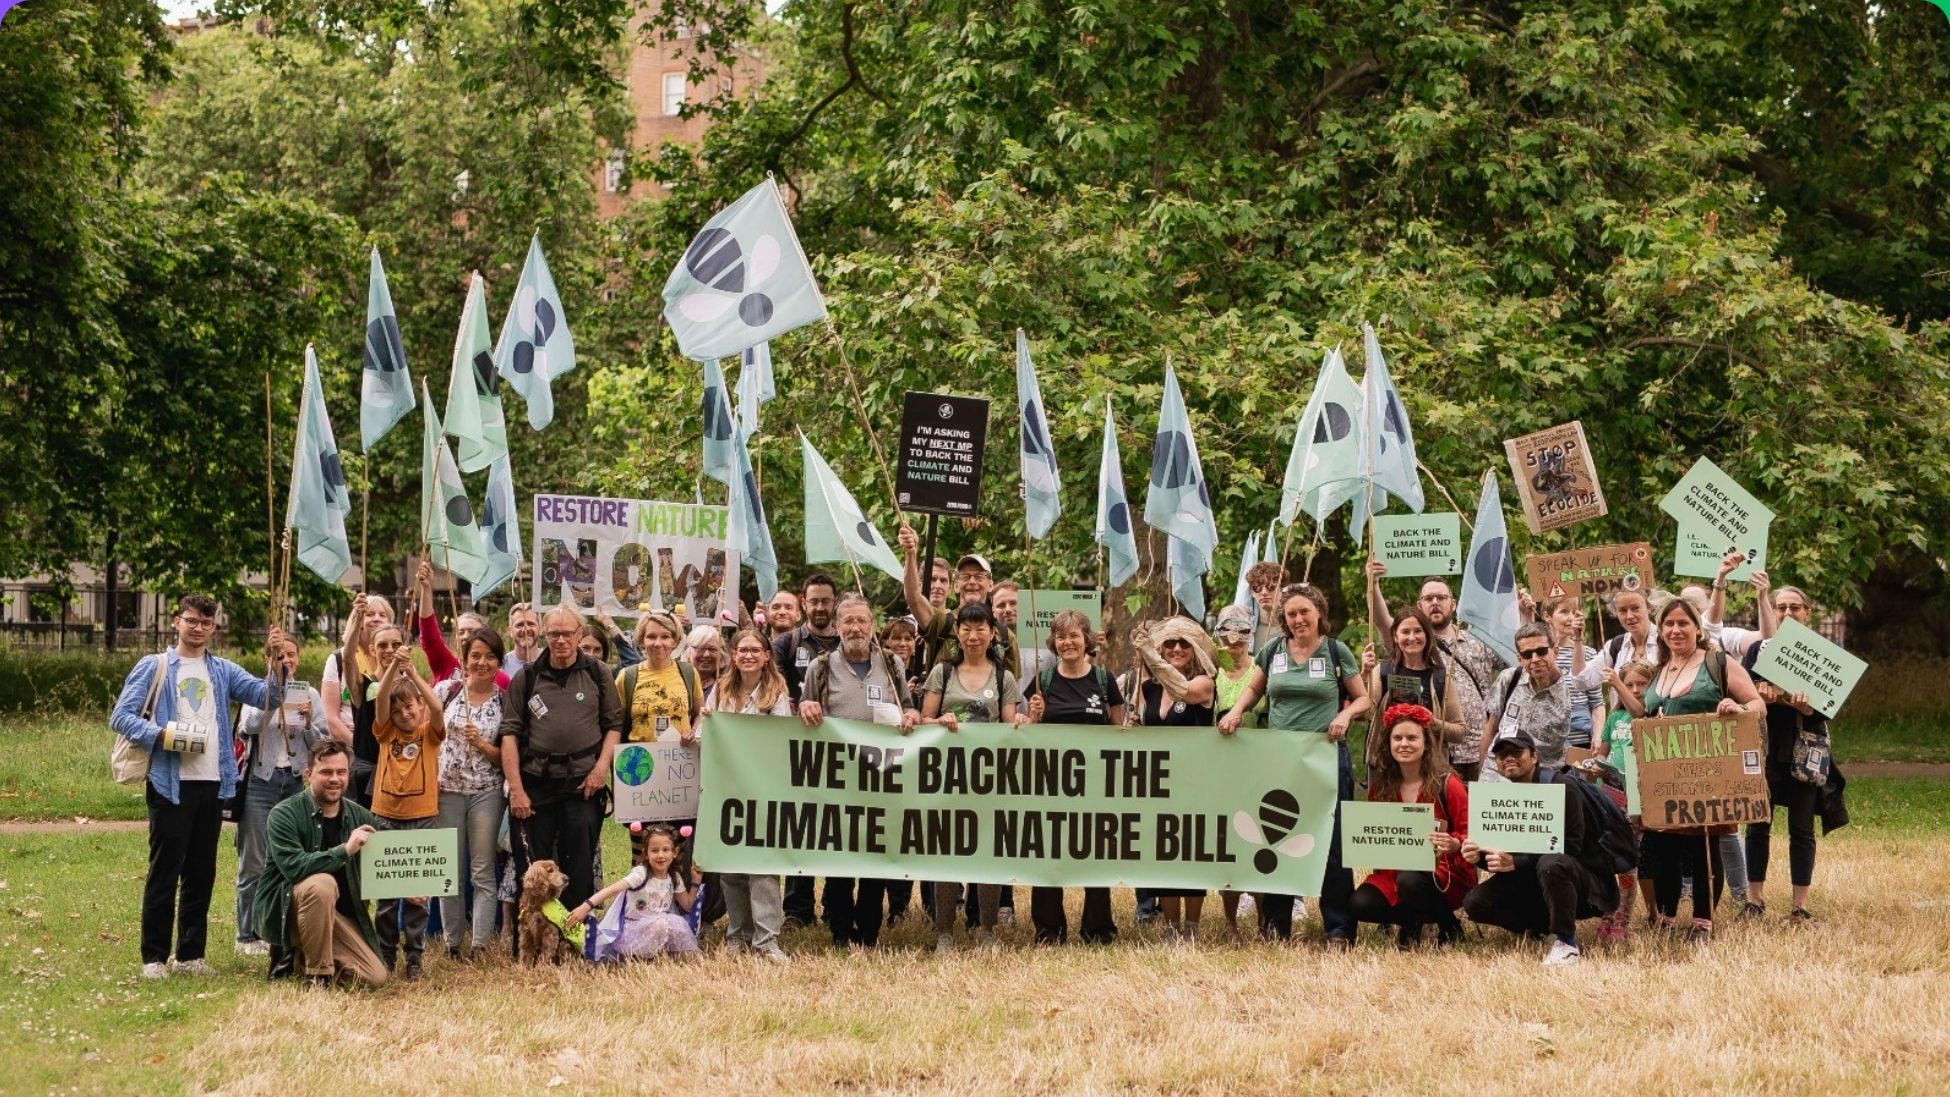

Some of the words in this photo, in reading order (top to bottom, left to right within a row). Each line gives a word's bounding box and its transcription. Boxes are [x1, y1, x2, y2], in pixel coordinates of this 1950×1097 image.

[917, 426, 932, 435] I'M
[934, 428, 970, 439] ASKING
[912, 437, 927, 446] MY
[929, 439, 956, 450] NEXT
[957, 442, 973, 451] MP
[909, 448, 923, 457] TO
[925, 450, 951, 460] BACK
[954, 453, 973, 462] THE
[1526, 440, 1577, 467] STOP
[907, 460, 950, 471] CLIMATE
[951, 464, 972, 473] AND
[907, 471, 947, 482] NATURE
[949, 476, 970, 485] BILL
[1537, 491, 1597, 517] ECOCIDE
[1705, 482, 1731, 505] BACK
[1730, 502, 1749, 521] THE
[1690, 485, 1729, 519] CLIMATE
[1728, 517, 1748, 535] AND
[537, 498, 628, 527] RESTORE
[638, 504, 728, 540] NATURE
[1684, 495, 1719, 527] NATURE
[1718, 524, 1738, 543] BILL
[1393, 529, 1419, 538] BACK
[1422, 528, 1442, 536] THE
[1385, 540, 1427, 549] CLIMATE
[1430, 539, 1451, 547] AND
[1387, 551, 1426, 560] NATURE
[1429, 550, 1450, 558] BILL
[1691, 550, 1722, 559] NATUR
[1538, 555, 1580, 573] SPEAK
[1587, 555, 1602, 568] UP
[1609, 553, 1637, 568] FOR
[541, 538, 725, 619] NOW
[1560, 566, 1639, 582] NATURE
[1580, 578, 1624, 594] NOW
[1794, 641, 1821, 661] BACK
[1822, 657, 1842, 673] THE
[1780, 646, 1822, 675] CLIMATE
[1821, 672, 1843, 687] AND
[1775, 656, 1814, 683] NATURE
[1814, 680, 1834, 697] BILL
[1641, 719, 1740, 764] NATURE
[657, 748, 693, 761] THERE
[668, 762, 696, 781] NO
[789, 739, 904, 794] WE'RE
[918, 746, 1086, 798] BACKING
[1101, 750, 1170, 799] THE
[632, 785, 693, 807] PLANET
[1491, 799, 1519, 808] BACK
[1523, 800, 1544, 809] THE
[1481, 811, 1528, 820] CLIMATE
[1531, 812, 1554, 821] AND
[719, 798, 886, 854] CLIMATE
[900, 808, 978, 857] AND
[994, 809, 1141, 861] NATURE
[1155, 813, 1237, 863] BILL
[1363, 826, 1413, 835] RESTORE
[1482, 823, 1525, 832] NATURE
[1529, 824, 1552, 834] BILL
[1352, 836, 1395, 846] NATURE
[1399, 838, 1425, 846] NOW
[384, 846, 413, 855] BACK
[416, 845, 438, 854] THE
[374, 858, 422, 868] CLIMATE
[424, 857, 447, 865] AND
[376, 870, 420, 879] NATURE
[422, 869, 446, 878] BILL
